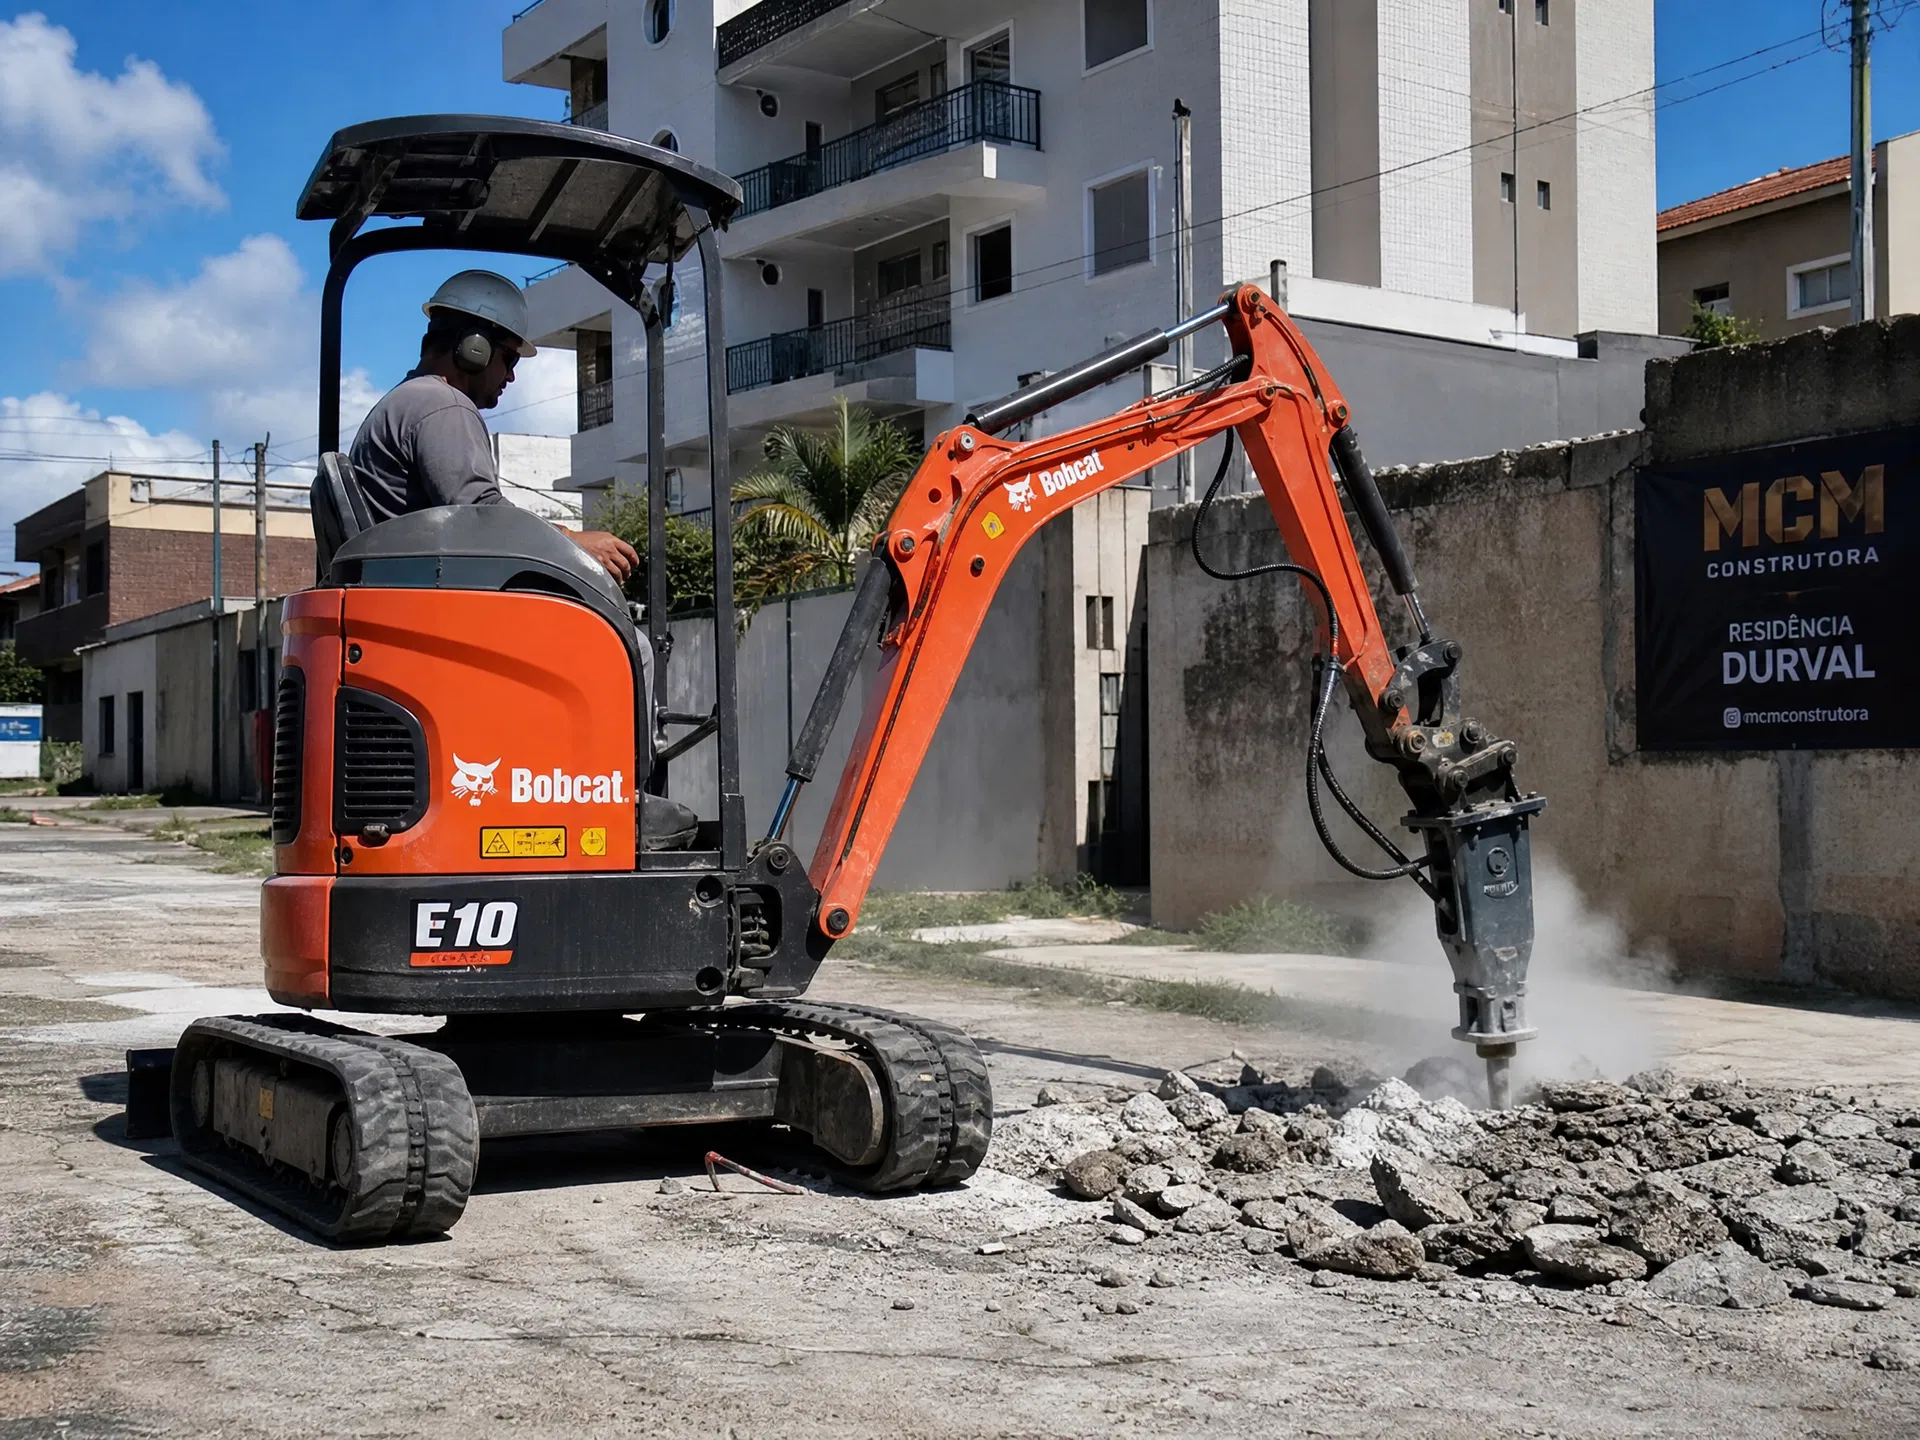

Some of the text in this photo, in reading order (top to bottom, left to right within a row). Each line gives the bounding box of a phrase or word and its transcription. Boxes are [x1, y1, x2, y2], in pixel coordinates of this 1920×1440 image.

[1038, 448, 1104, 497] Bobcat
[1703, 464, 1885, 552] MCM
[1706, 546, 1880, 579] CONSTRUTORA
[1728, 613, 1855, 643] RESIDÊNCIA
[1722, 644, 1876, 685] DURVAL
[1744, 706, 1869, 724] mcmconstrutora
[511, 767, 625, 804] Bobcat
[415, 901, 519, 948] E10
